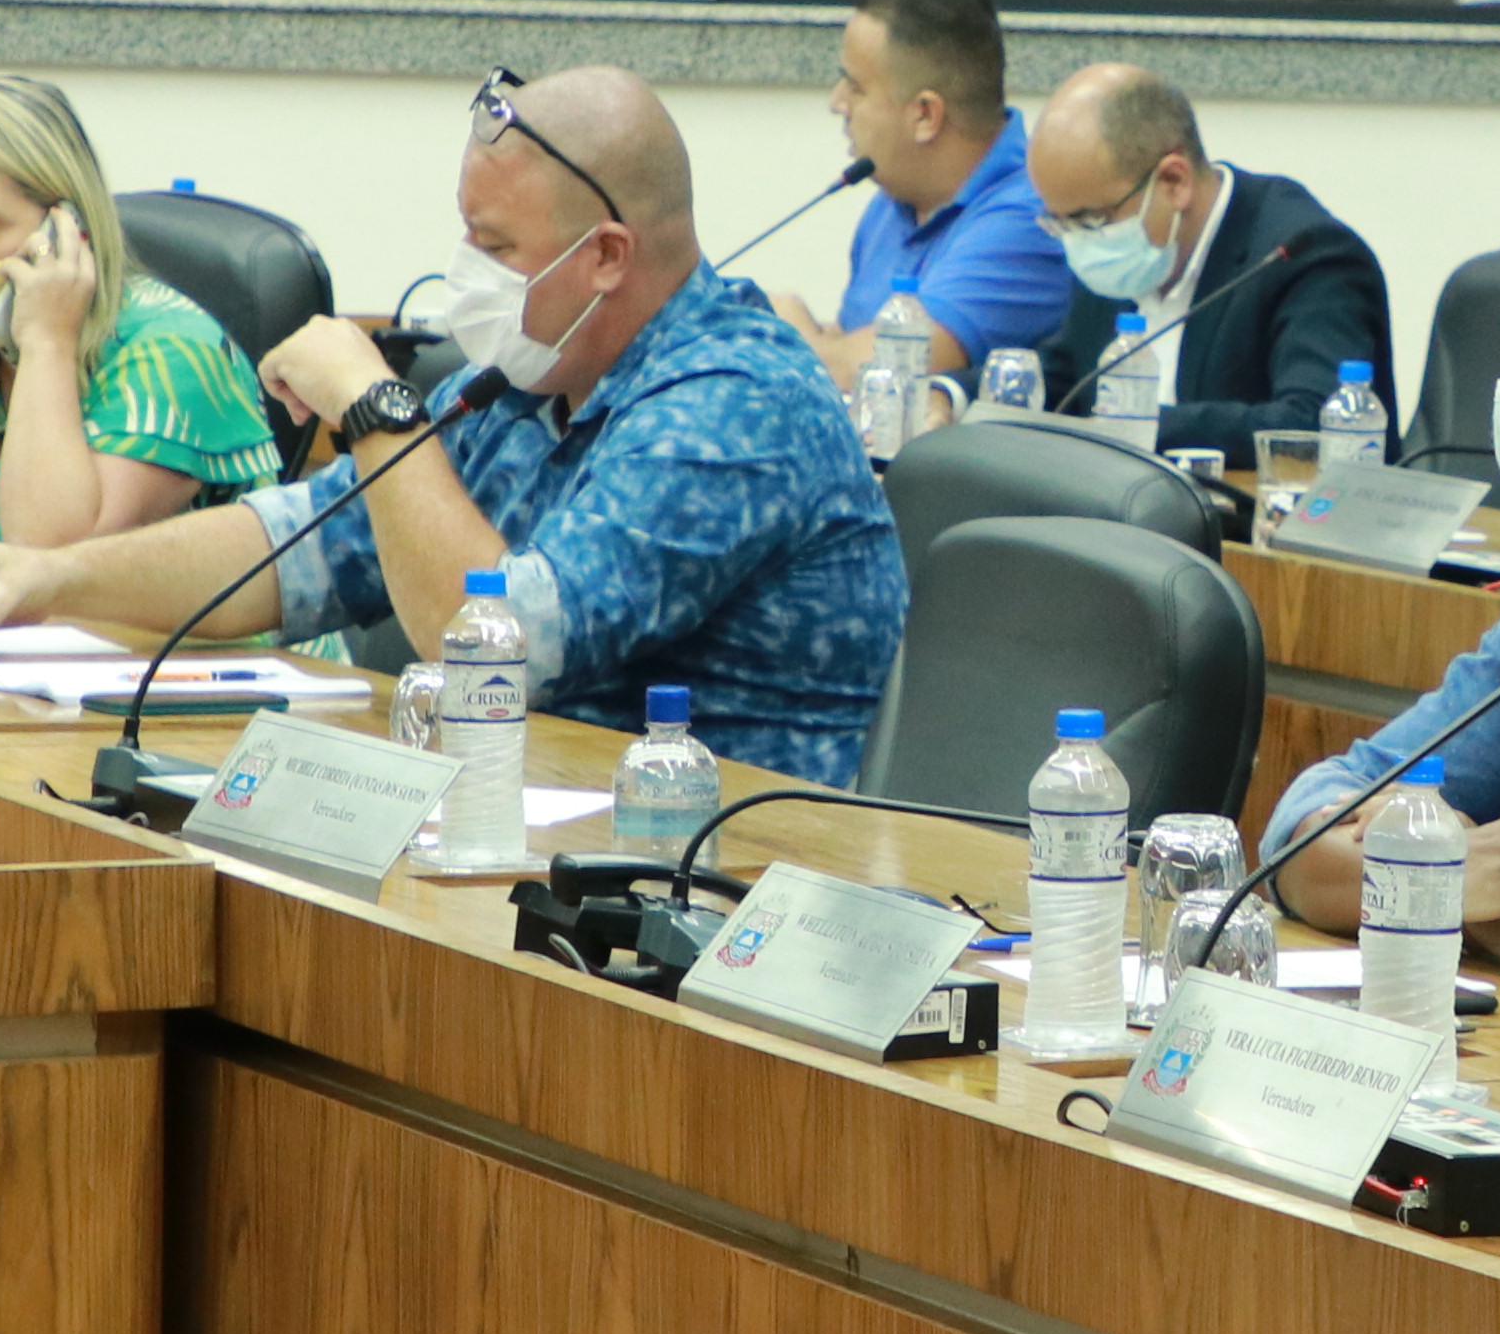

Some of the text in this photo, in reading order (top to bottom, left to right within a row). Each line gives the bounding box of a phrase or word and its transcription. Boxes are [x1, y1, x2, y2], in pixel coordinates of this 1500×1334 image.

[466, 691, 521, 706] CRISTAL
[1225, 1028, 1252, 1053] VERA
[1286, 1046, 1355, 1081] FIGUEIREDO
[1351, 1064, 1402, 1094] BENICIO
[1260, 1084, 1316, 1118] Vereadora
